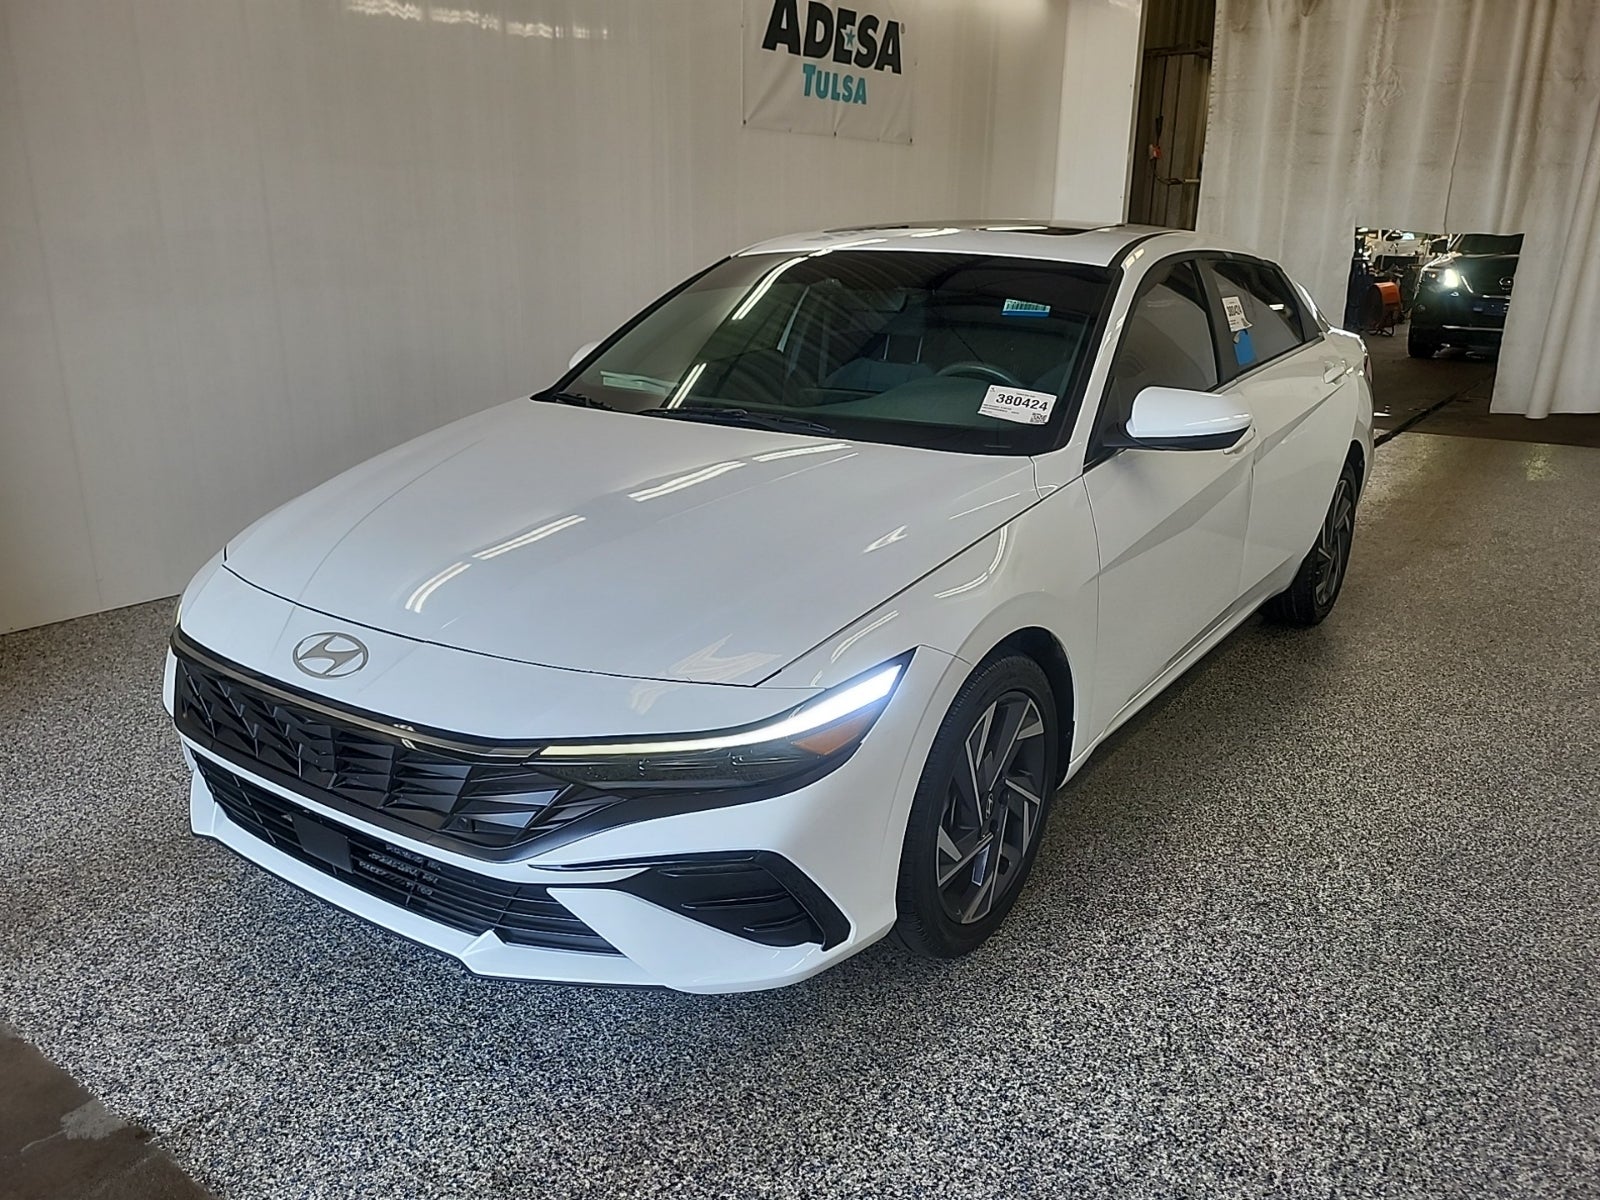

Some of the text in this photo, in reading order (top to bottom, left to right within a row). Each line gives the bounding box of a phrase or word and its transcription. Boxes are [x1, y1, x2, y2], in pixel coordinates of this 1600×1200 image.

[762, 0, 902, 74] ADESA
[803, 63, 867, 105] TULSA
[995, 393, 1048, 411] 380424
